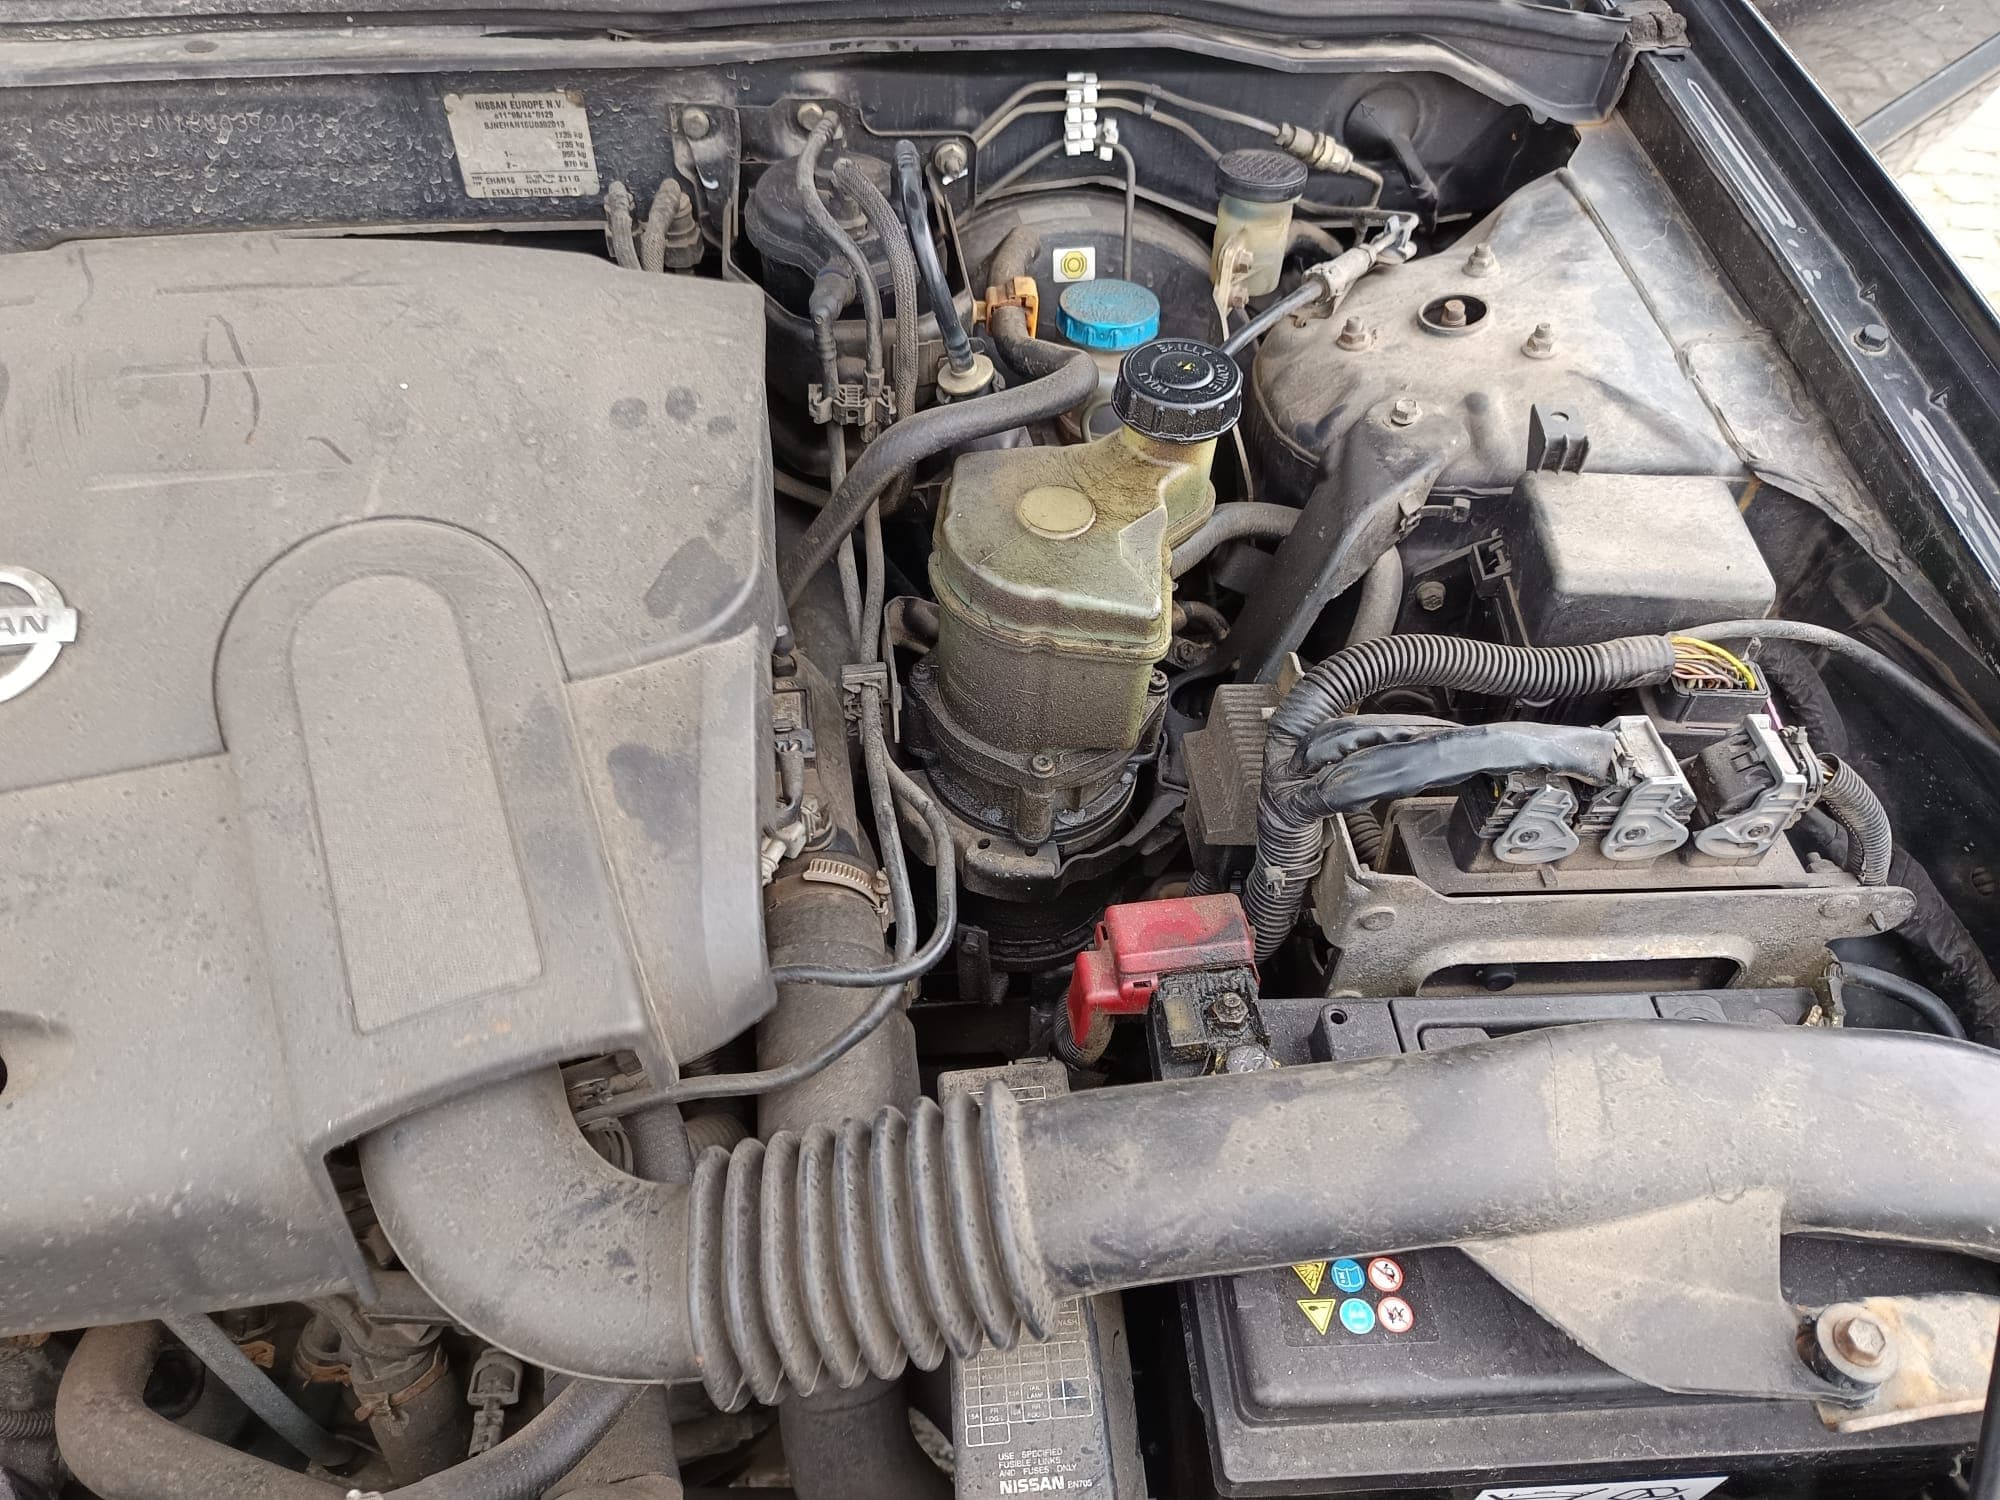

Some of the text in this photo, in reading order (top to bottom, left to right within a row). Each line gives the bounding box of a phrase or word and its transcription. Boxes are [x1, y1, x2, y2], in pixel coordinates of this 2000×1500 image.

[475, 100, 565, 110] NISSAN EUROPE N.V.
[998, 1448, 1063, 1460] USE SPECIFIED
[999, 1464, 1077, 1477] AND FUSES ONLY
[1000, 1476, 1065, 1495] NISSAN
